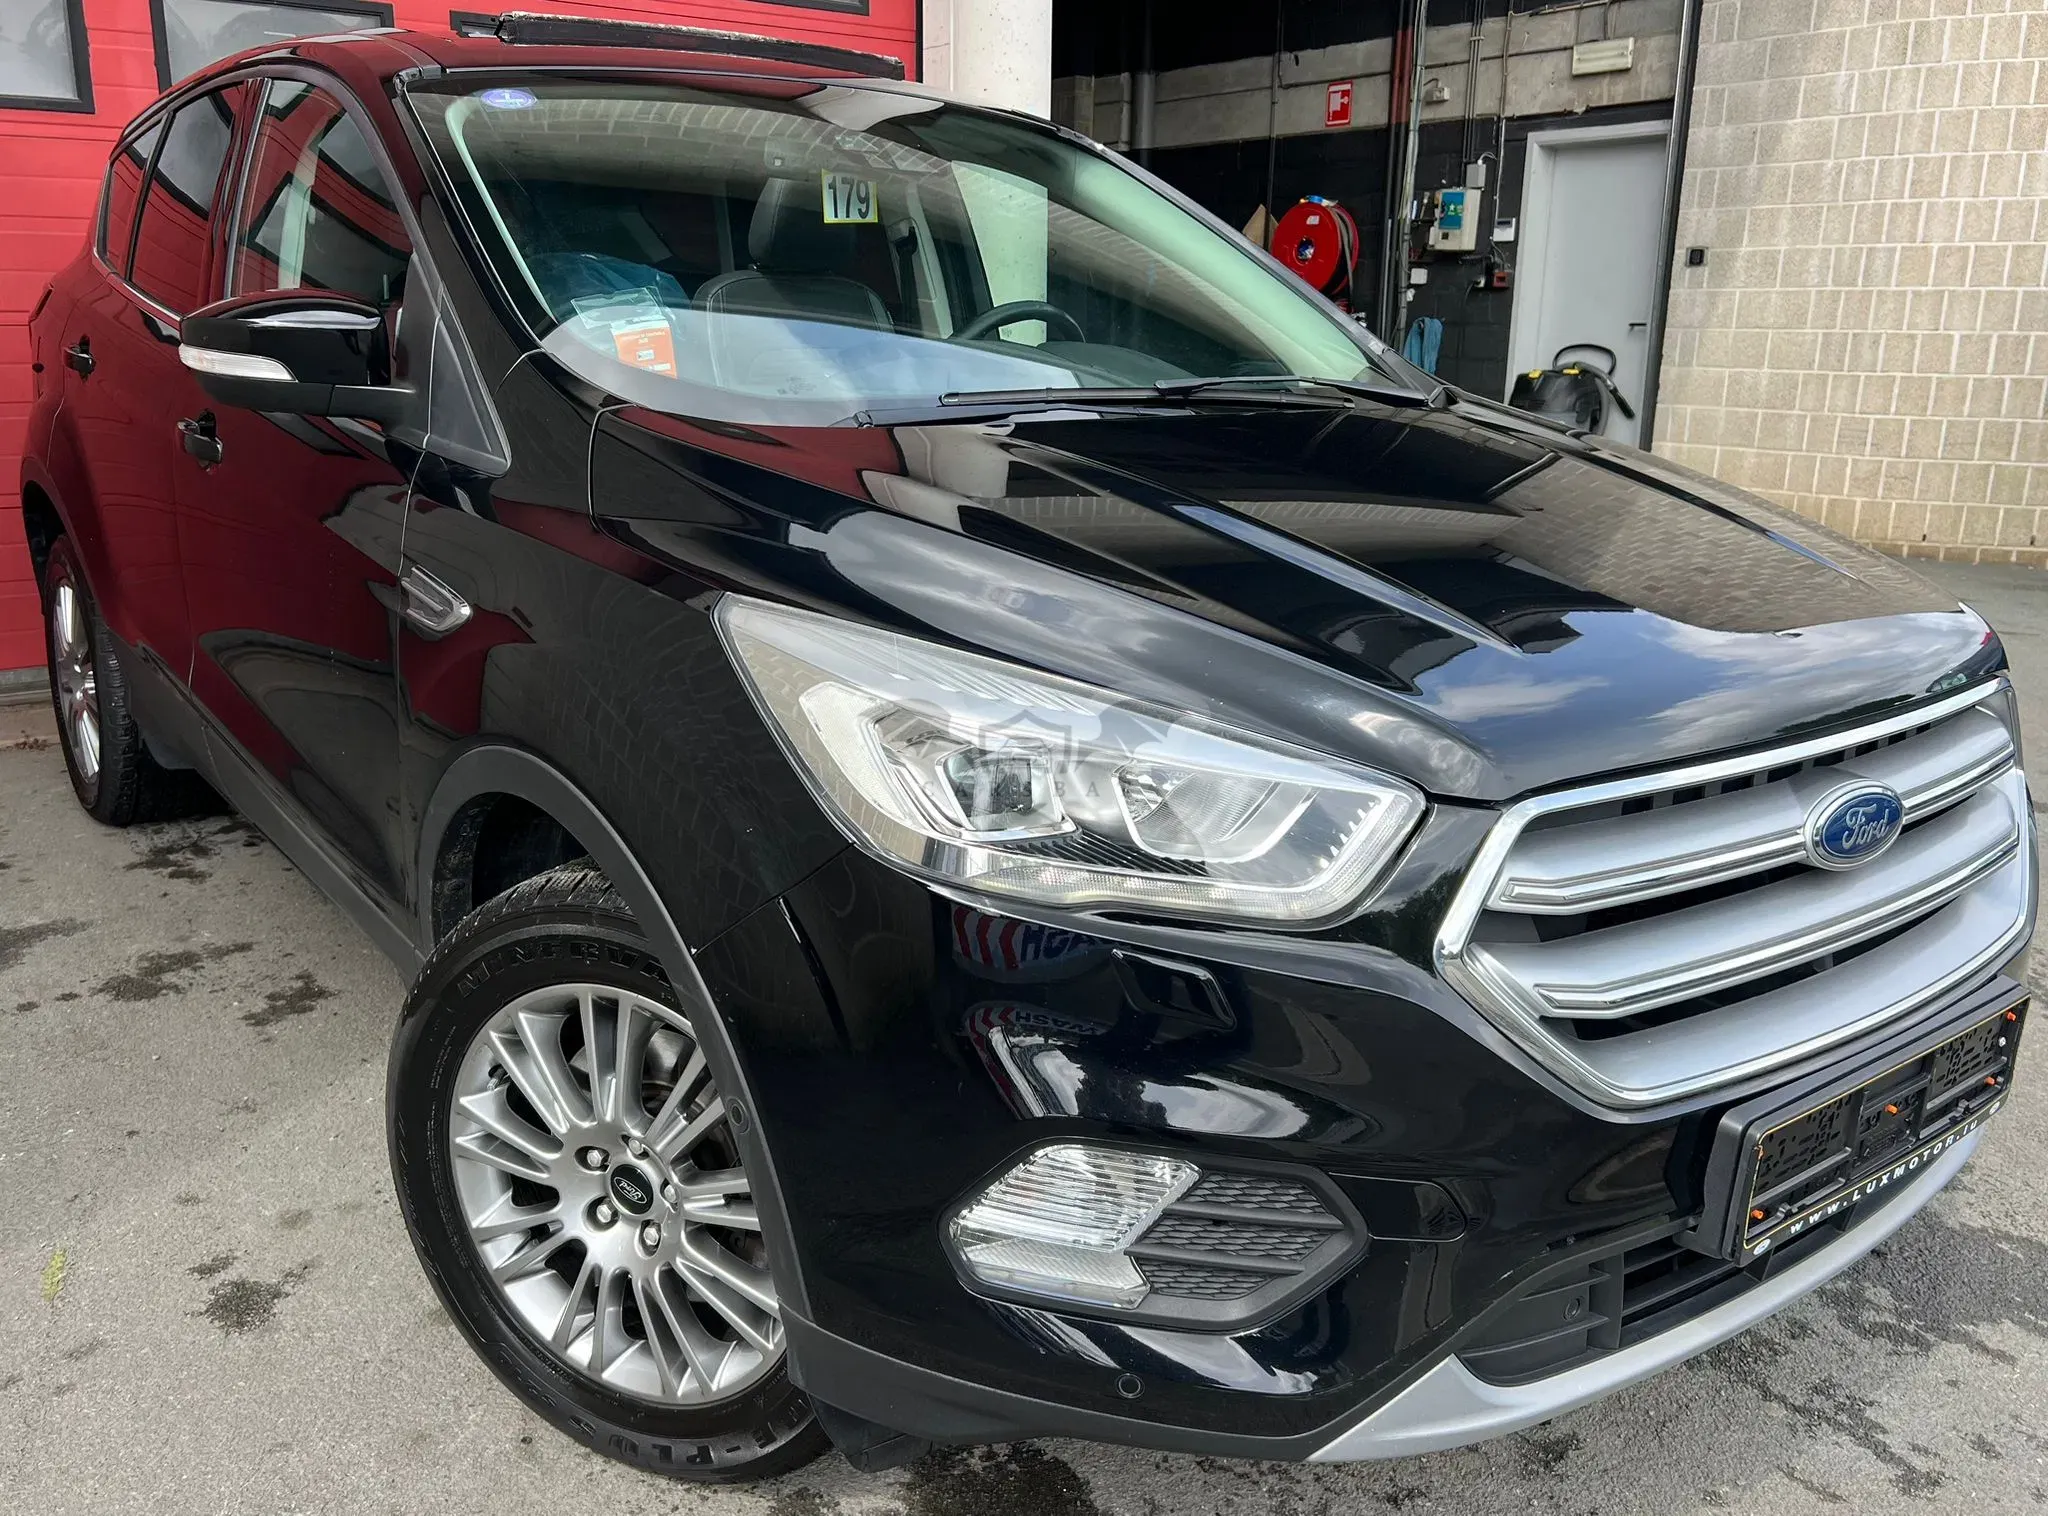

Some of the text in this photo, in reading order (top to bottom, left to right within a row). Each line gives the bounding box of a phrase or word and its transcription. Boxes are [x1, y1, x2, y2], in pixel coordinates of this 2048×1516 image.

[828, 175, 870, 219] 179
[1841, 803, 1889, 850] Ford
[618, 1180, 642, 1200] Ford
